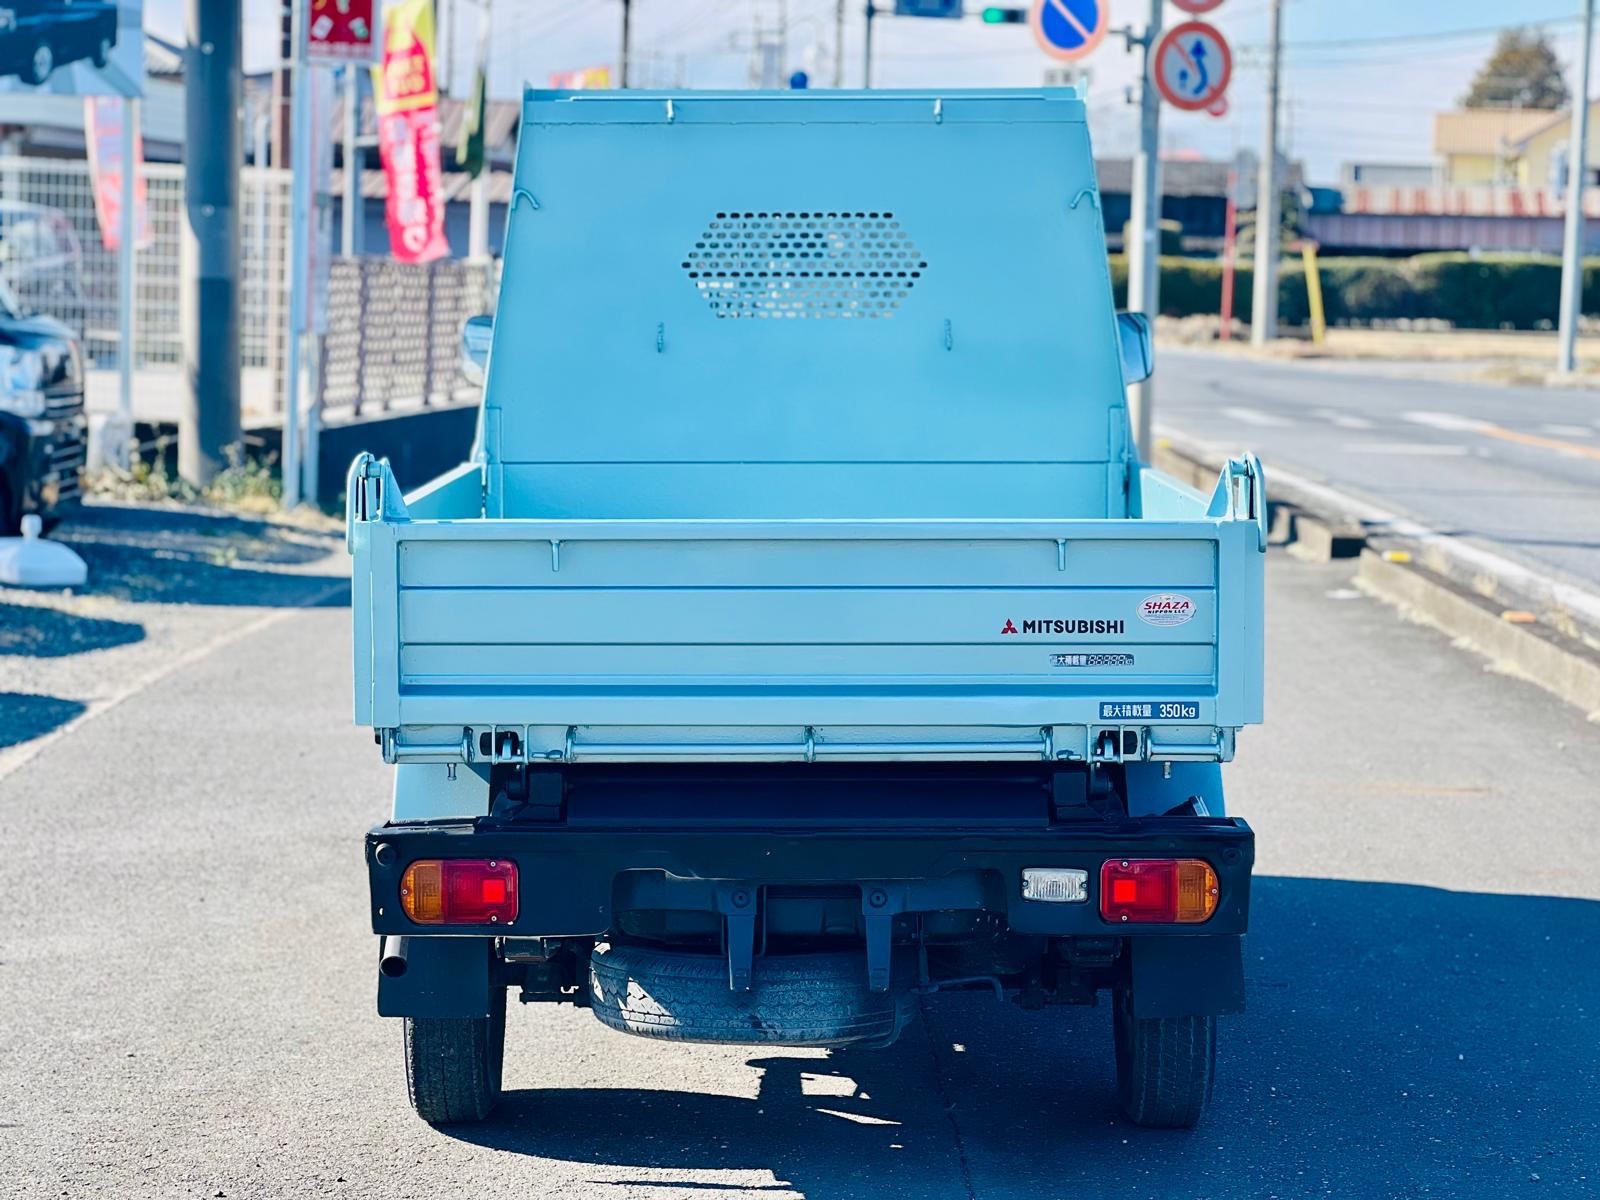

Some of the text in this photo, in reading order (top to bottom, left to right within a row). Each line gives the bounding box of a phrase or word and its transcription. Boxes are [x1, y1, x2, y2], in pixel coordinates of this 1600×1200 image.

[1144, 601, 1189, 610] SHAZA
[1023, 620, 1124, 633] MITSUBISHI
[1103, 704, 1196, 717] 最大積載量 350kg
